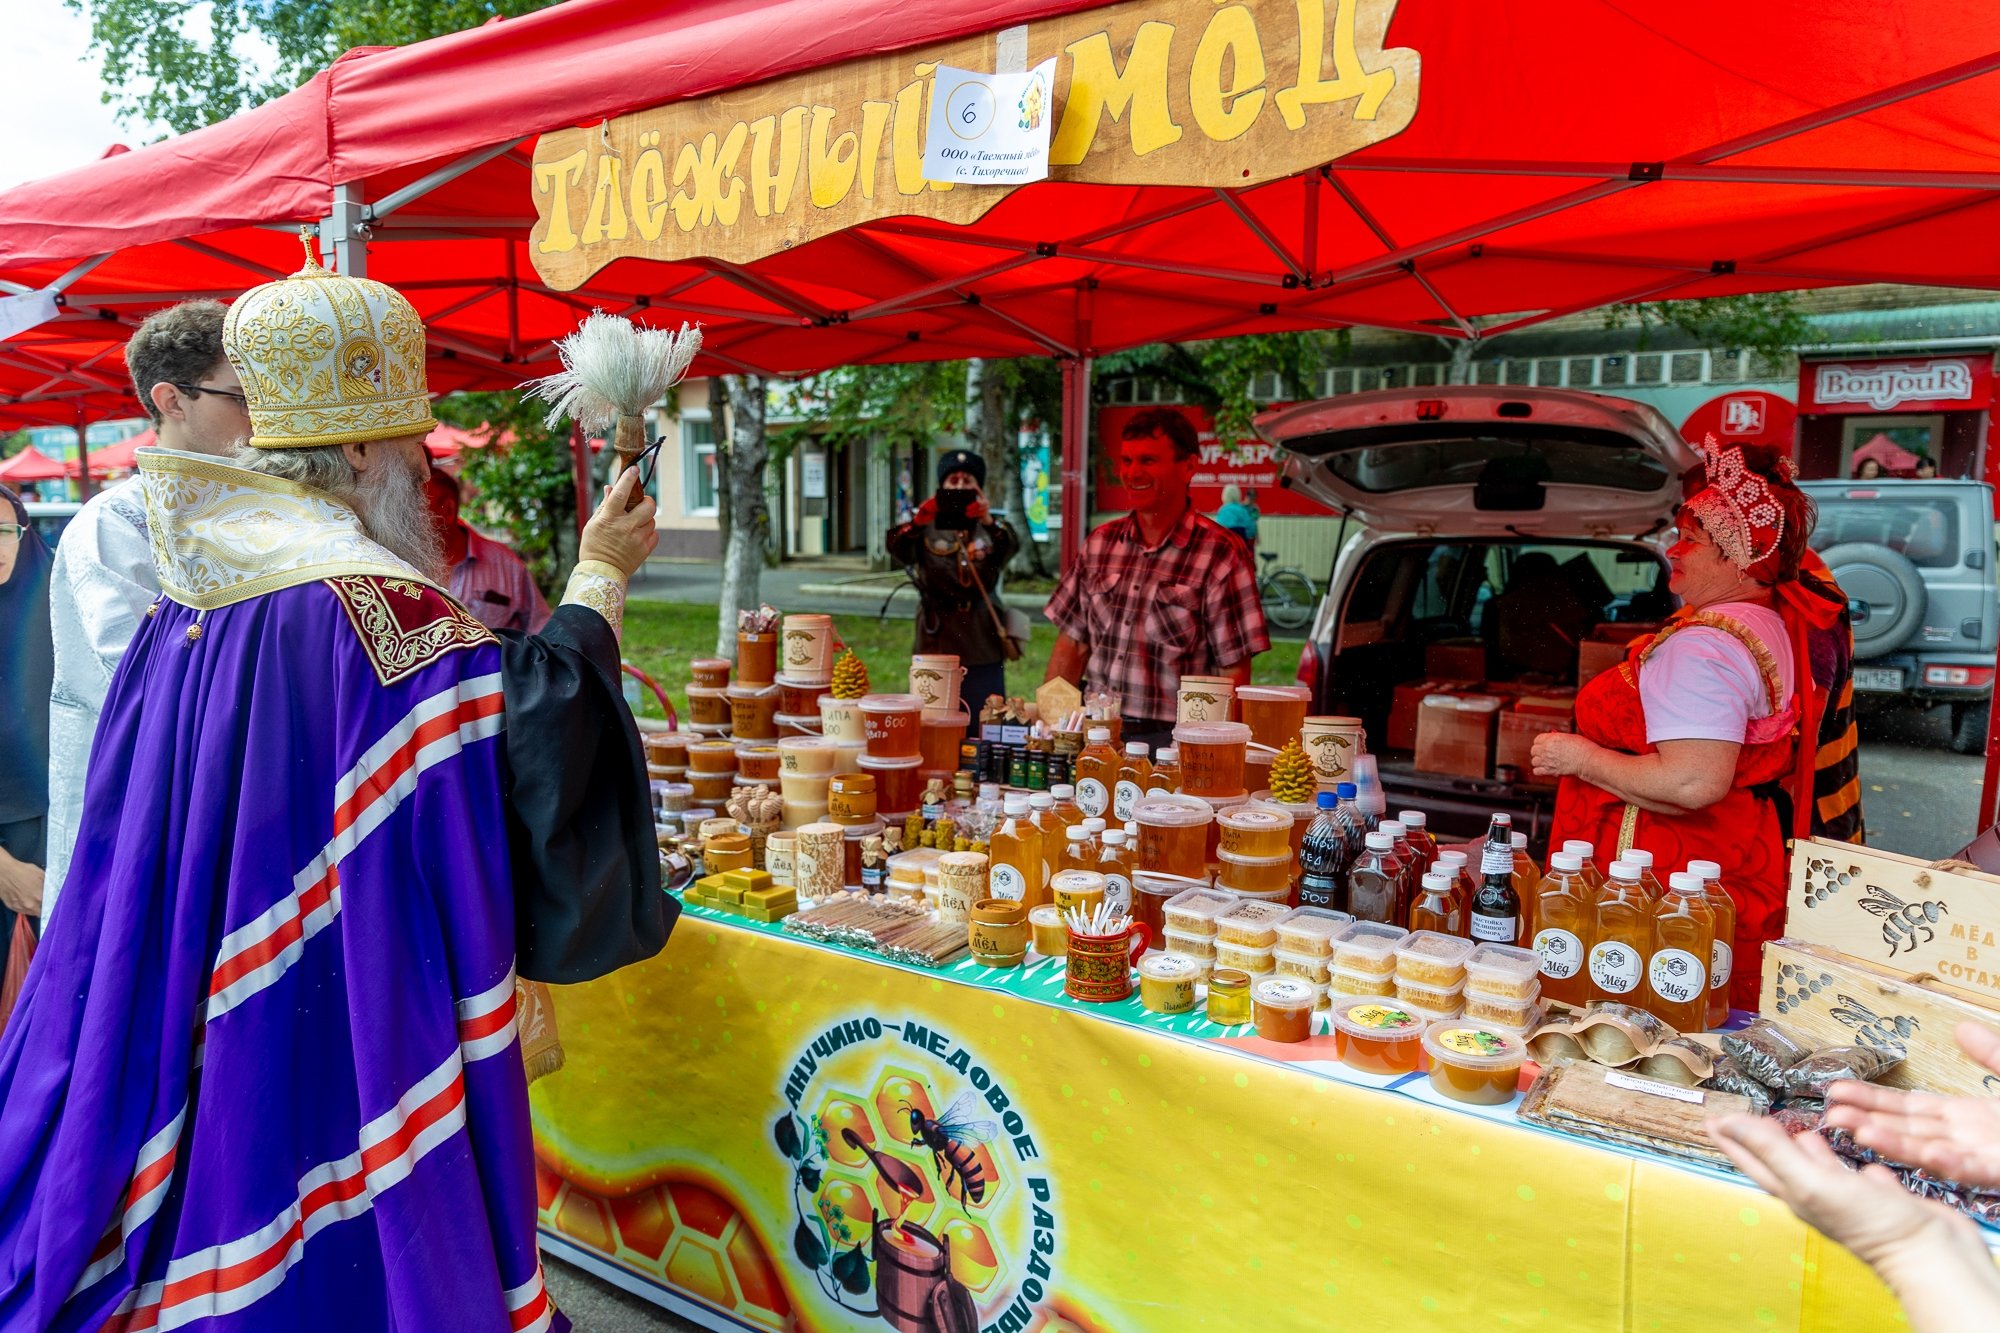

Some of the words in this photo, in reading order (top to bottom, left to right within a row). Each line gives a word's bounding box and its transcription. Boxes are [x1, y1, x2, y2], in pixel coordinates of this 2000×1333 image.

[962, 102, 977, 124] 6
[941, 147, 969, 161] ООО
[972, 165, 1029, 178] Тихоречное)
[885, 715, 907, 728] 600
[1301, 888, 1329, 904] 500
[1950, 922, 1996, 947] МЁД
[1967, 946, 1979, 961] В
[1544, 959, 1570, 977] Мёд
[1937, 960, 2000, 990] СОТАХ
[1601, 974, 1628, 991] Мёд
[1661, 981, 1689, 1000] Мёд
